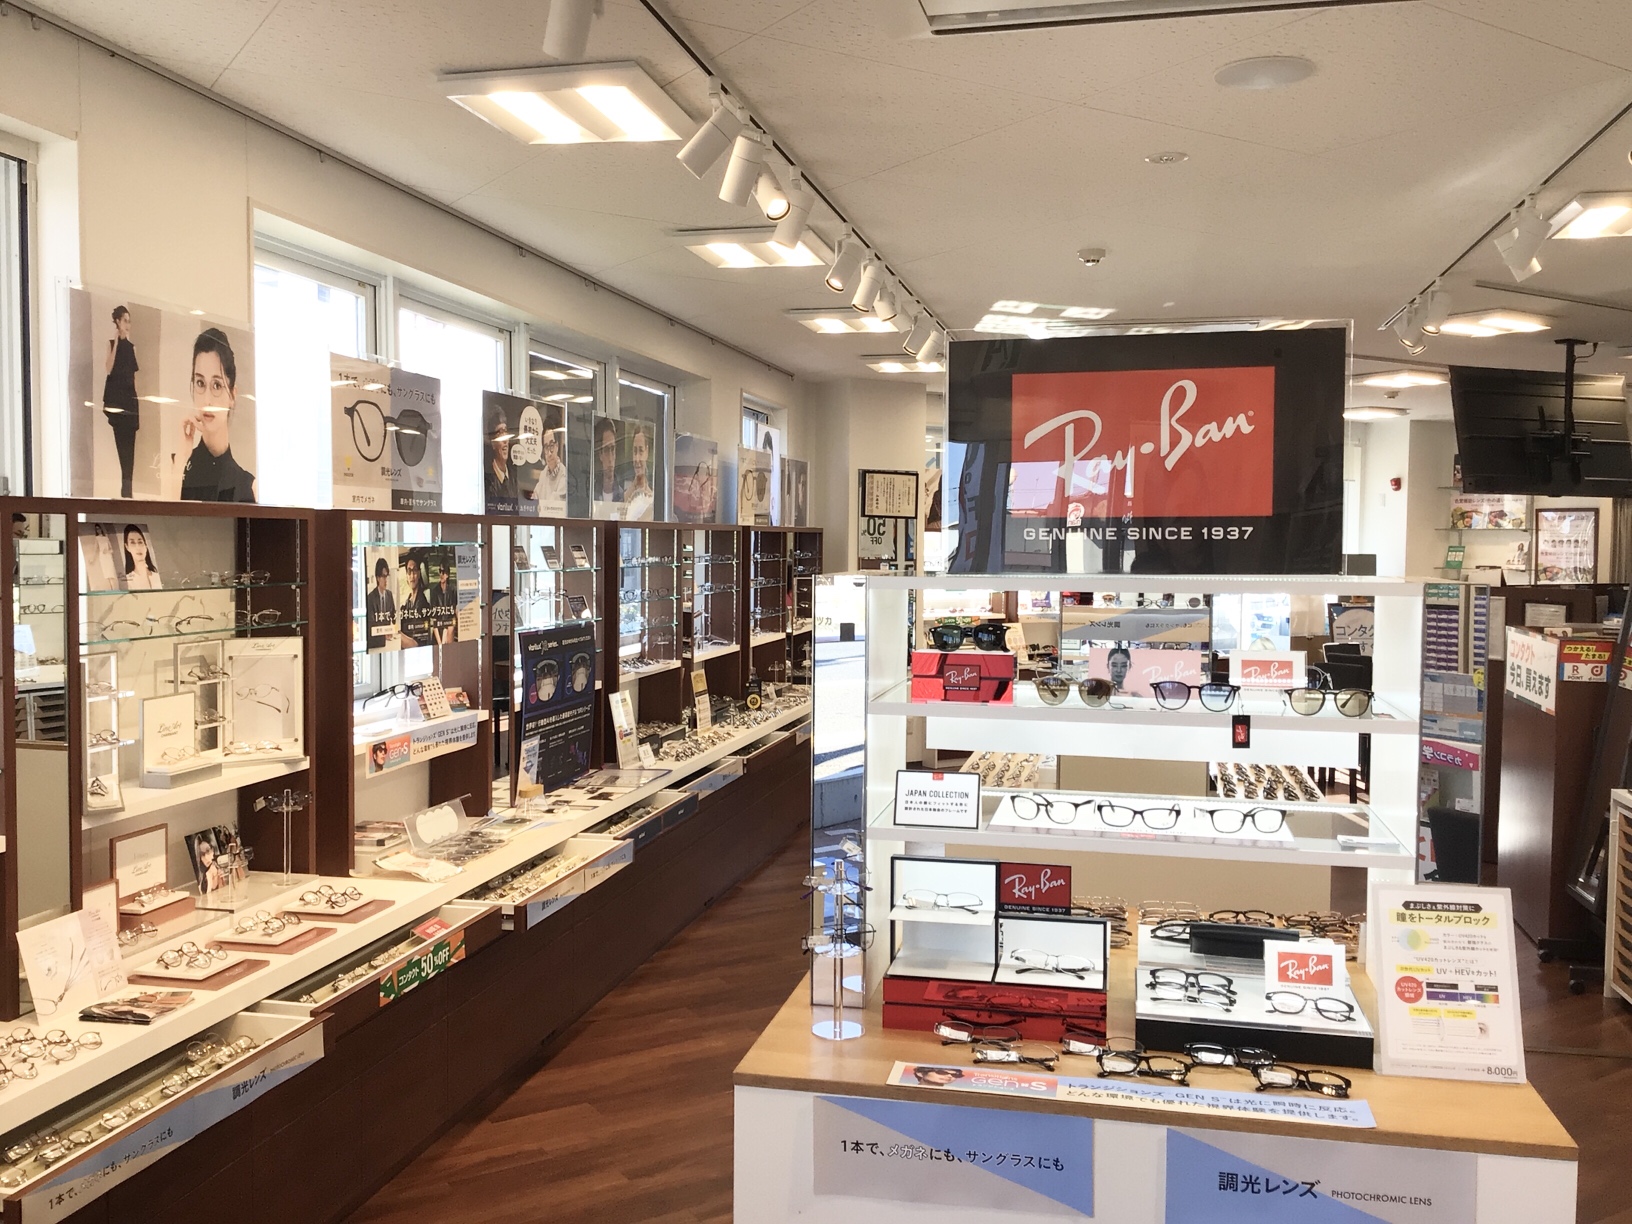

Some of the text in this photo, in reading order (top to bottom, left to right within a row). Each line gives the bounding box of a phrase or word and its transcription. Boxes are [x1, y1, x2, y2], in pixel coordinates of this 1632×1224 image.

[1127, 527, 1193, 540] SINCE
[1201, 526, 1254, 540] 1937
[905, 789, 970, 799] JAPAN COLLECTION
[1396, 912, 1490, 926] 瞳をトータルブロック
[398, 966, 420, 986] コンタクト
[232, 1067, 267, 1100] 調光レンズ
[840, 1139, 1065, 1171] 1本で、メガネにも、サングラスにも
[1218, 1171, 1321, 1199] 調光レンズ
[1331, 1189, 1432, 1207] PHOTOCHROMIC LENS
